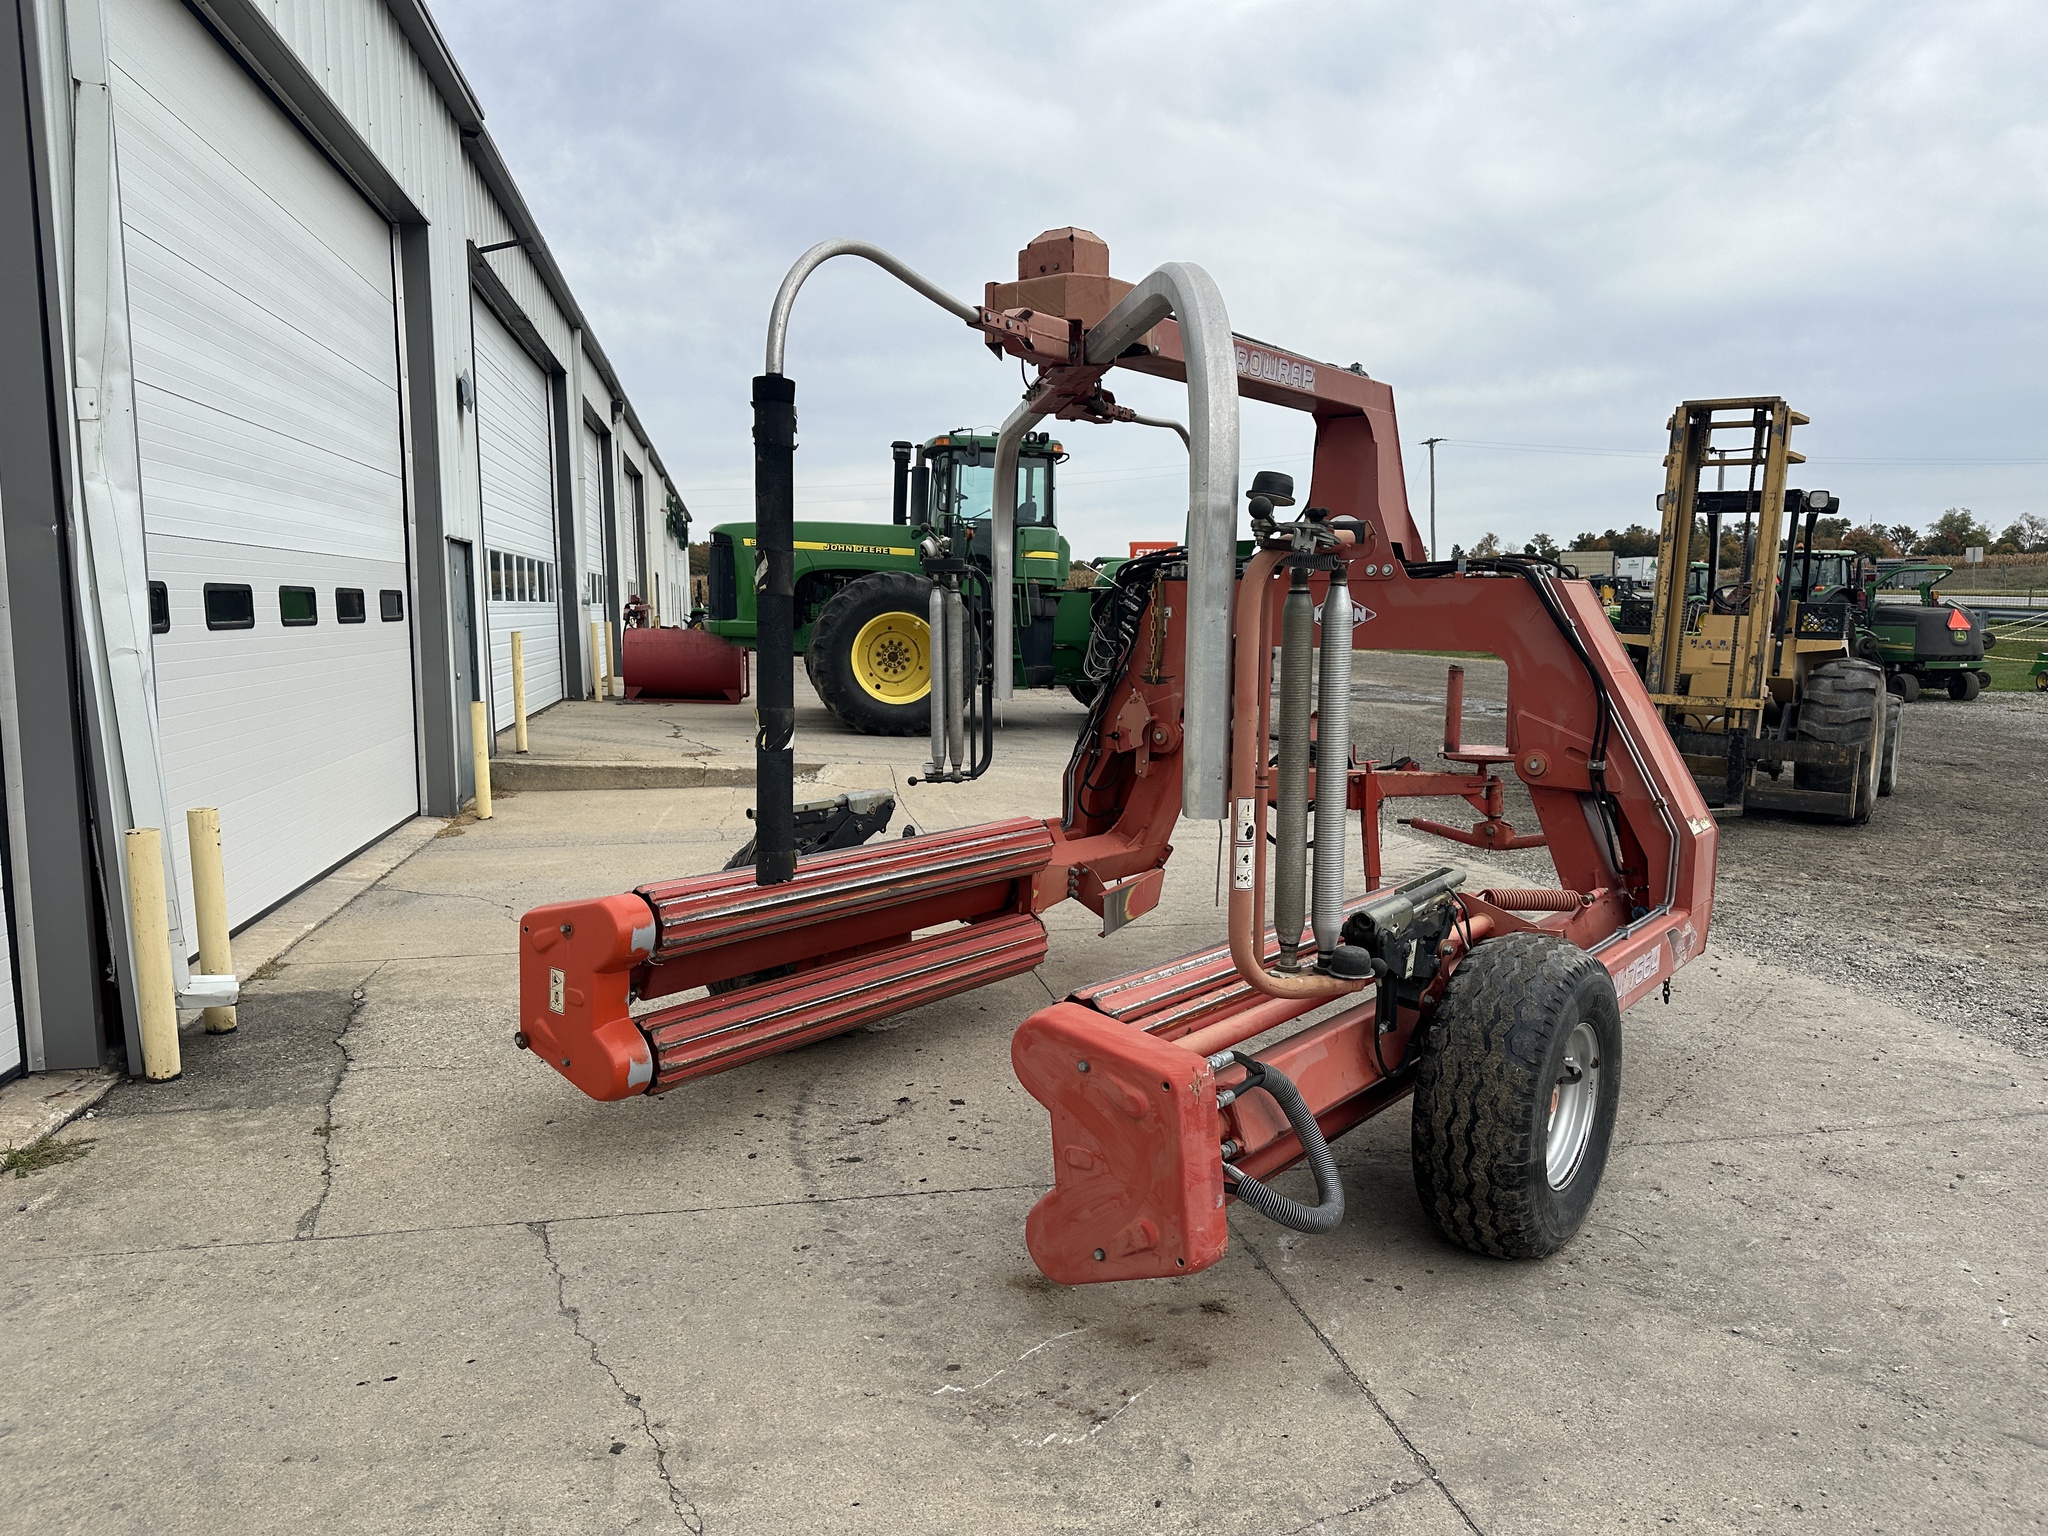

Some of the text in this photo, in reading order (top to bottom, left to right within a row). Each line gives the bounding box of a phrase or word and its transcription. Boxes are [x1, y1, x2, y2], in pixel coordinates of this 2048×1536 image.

[1234, 346, 1314, 388] ROWRAP
[855, 545, 890, 555] DEERE
[1314, 607, 1366, 622] KN
